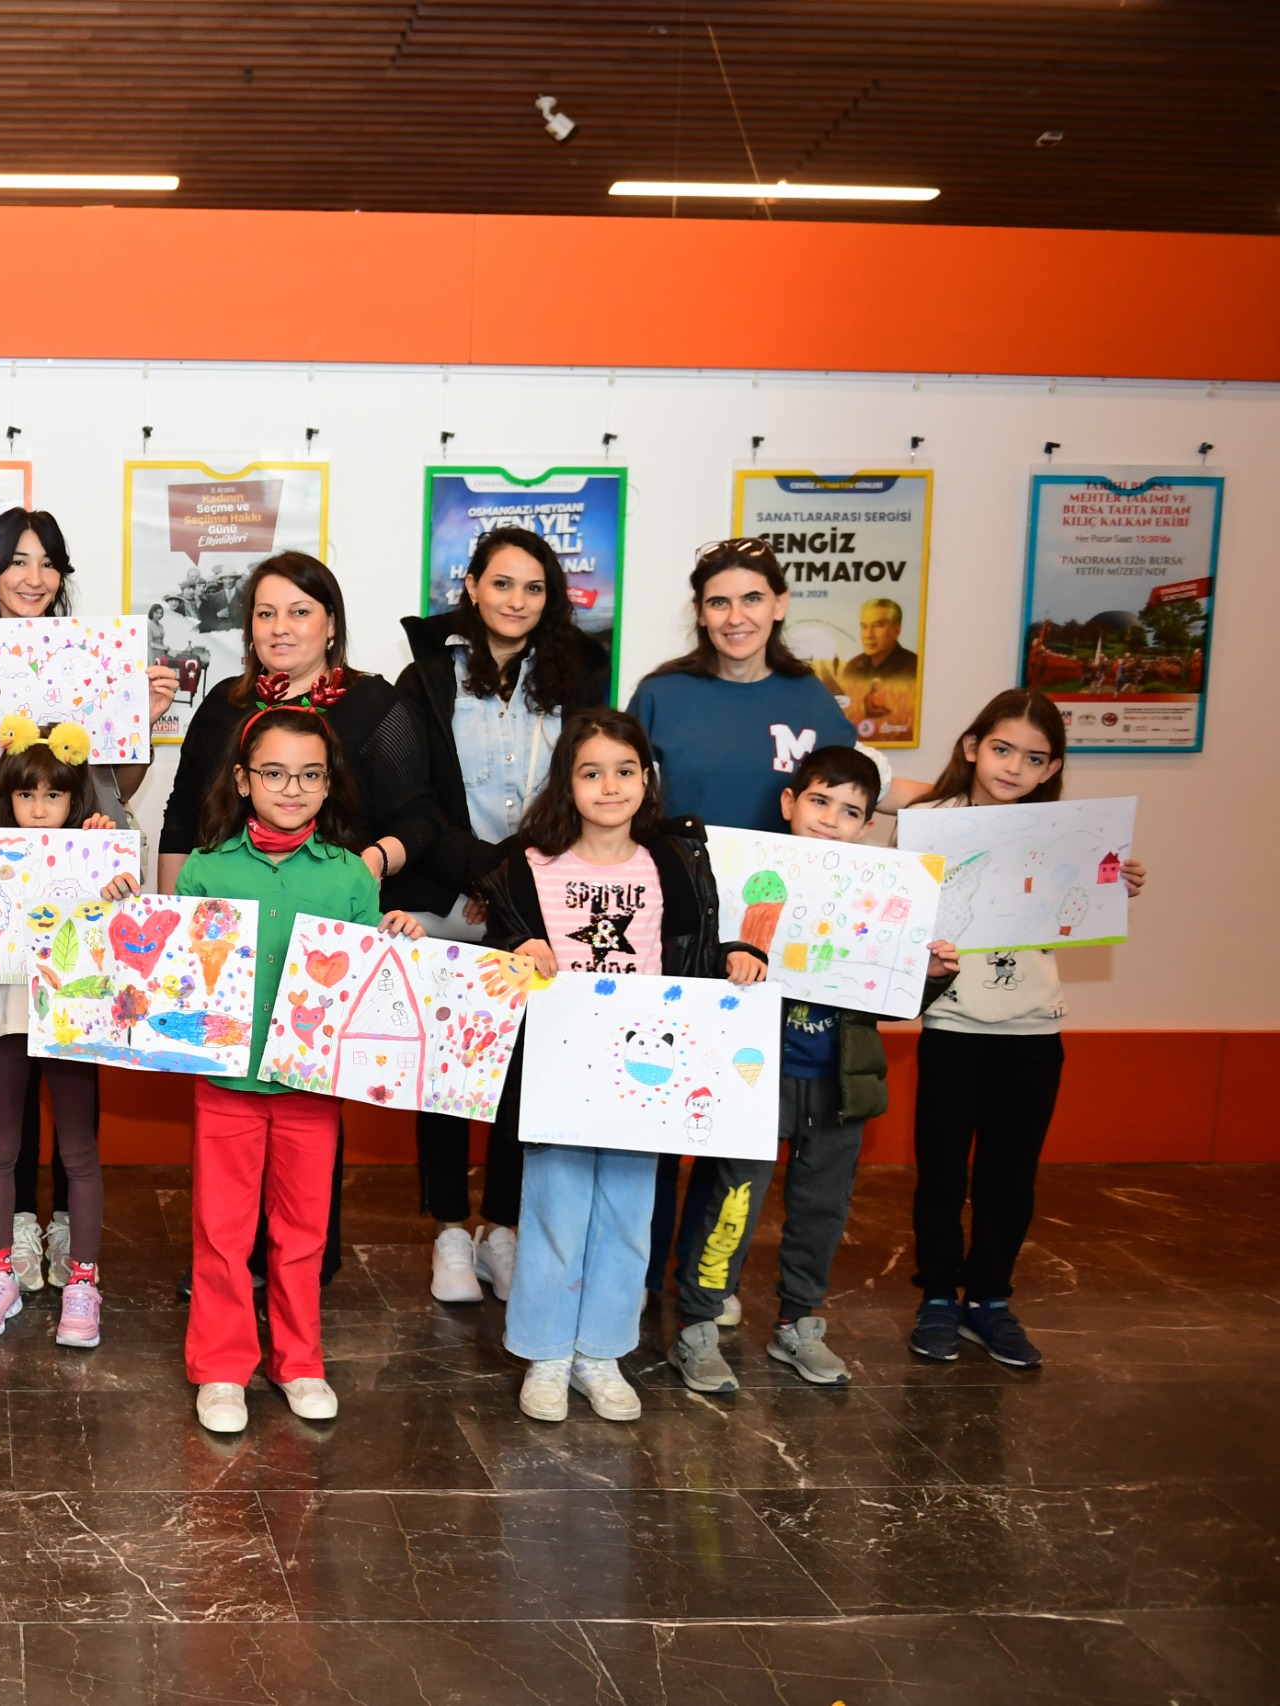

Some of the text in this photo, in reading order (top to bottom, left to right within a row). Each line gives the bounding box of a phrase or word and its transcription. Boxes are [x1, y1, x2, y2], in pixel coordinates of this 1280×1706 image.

[202, 494, 244, 503] Kadının
[1069, 493, 1122, 503] MEHTER
[196, 503, 250, 515] Seçme ve
[1062, 504, 1191, 515] BURSA TAHTA KIRAN
[183, 513, 261, 526] Seçilme Hakkı
[756, 508, 912, 522] SANATLARARASI SERGİSİ
[1062, 515, 1190, 528] KILIÇ KALKAN EKİBİ
[208, 524, 237, 534] Günü
[1075, 535, 1090, 544] Her
[1091, 534, 1113, 544] Pazar
[782, 561, 907, 583] TMATOV
[1075, 566, 1104, 576] FETİH
[769, 723, 817, 774] M
